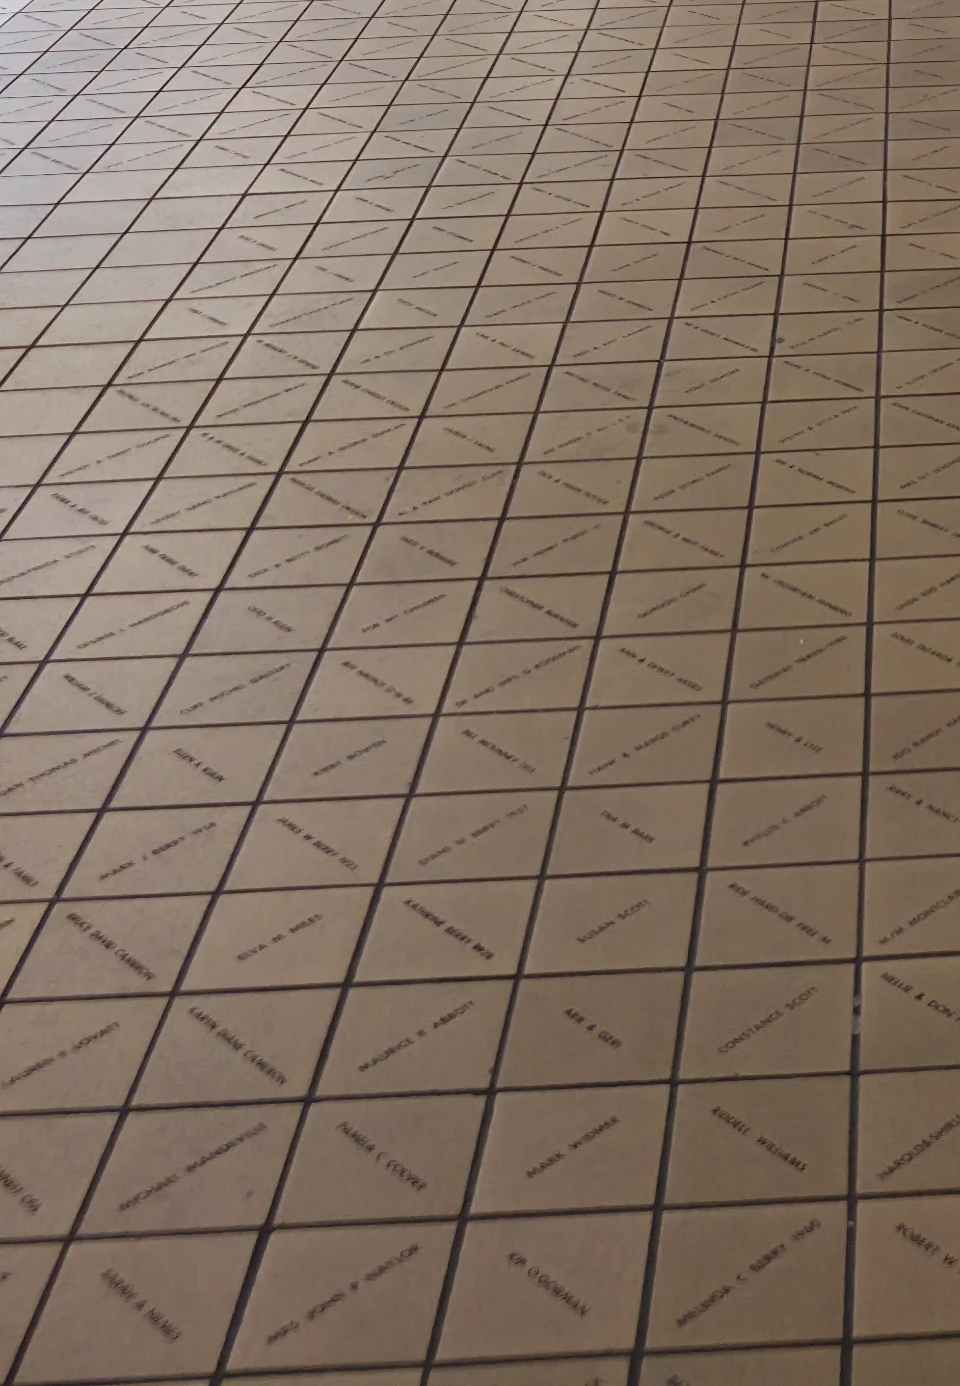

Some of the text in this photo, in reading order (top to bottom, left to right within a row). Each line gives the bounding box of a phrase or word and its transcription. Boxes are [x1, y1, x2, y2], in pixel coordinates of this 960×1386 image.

[576, 898, 650, 943] SUSAN SCOTT
[716, 986, 818, 1053] CONSTANCE SCOTT
[927, 999, 955, 1017] DON
[525, 1151, 564, 1178] MARK
[894, 1222, 940, 1256] ROBERT
